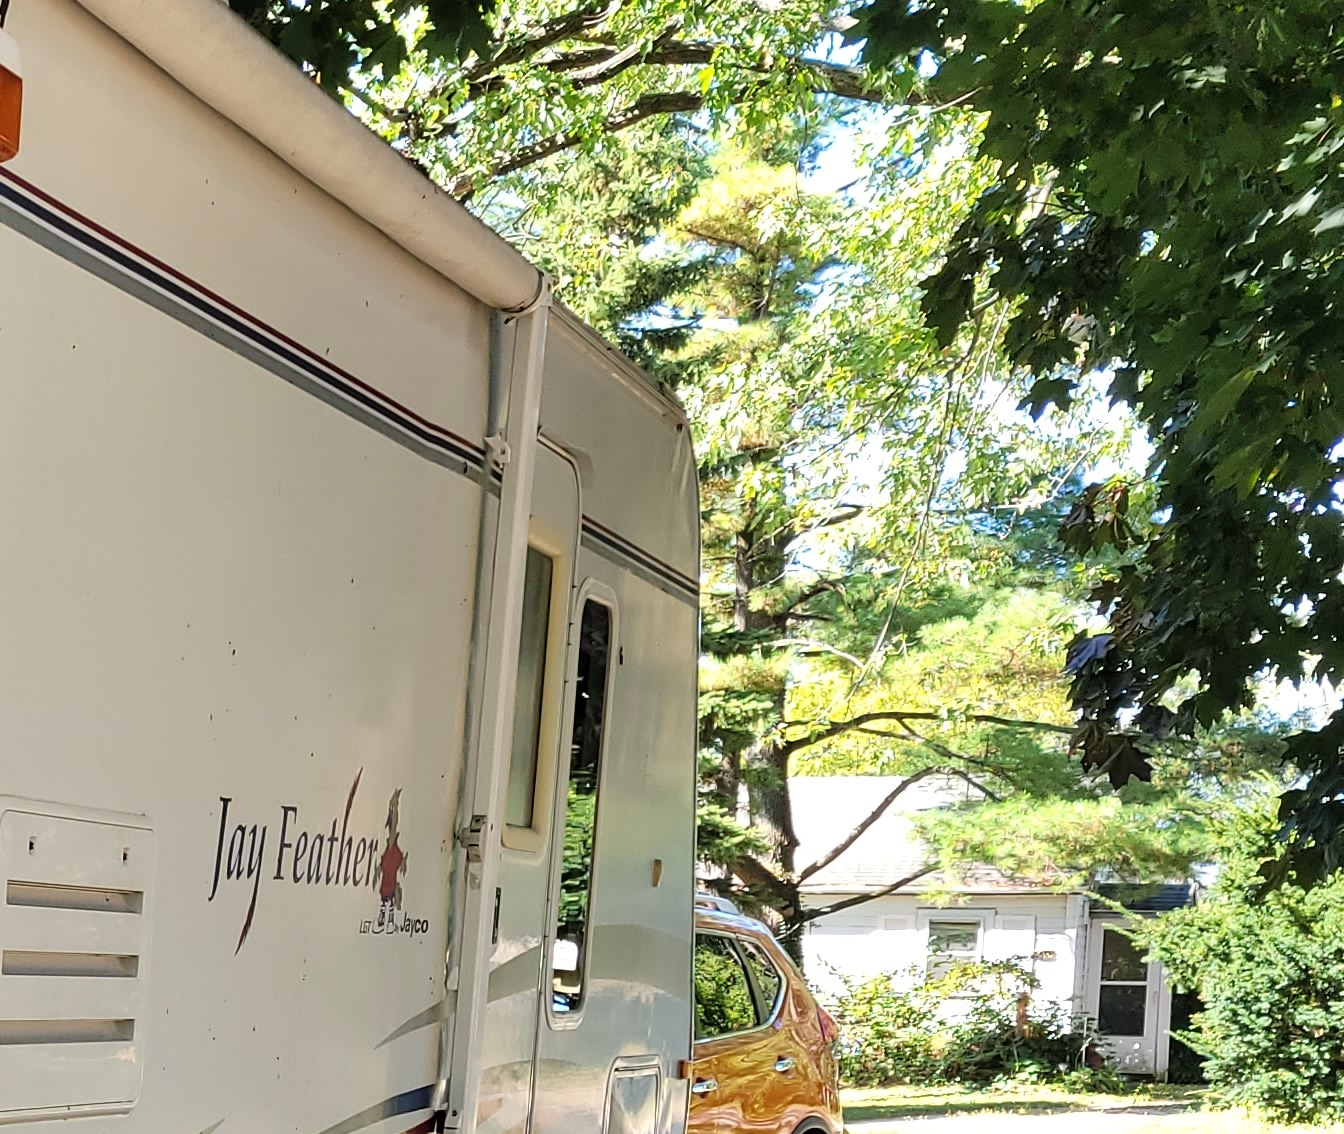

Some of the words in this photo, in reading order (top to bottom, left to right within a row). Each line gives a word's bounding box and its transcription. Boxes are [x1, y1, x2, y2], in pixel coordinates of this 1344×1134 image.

[208, 796, 268, 956] Jay
[273, 766, 380, 888] Feather
[400, 911, 429, 938] Jayco
